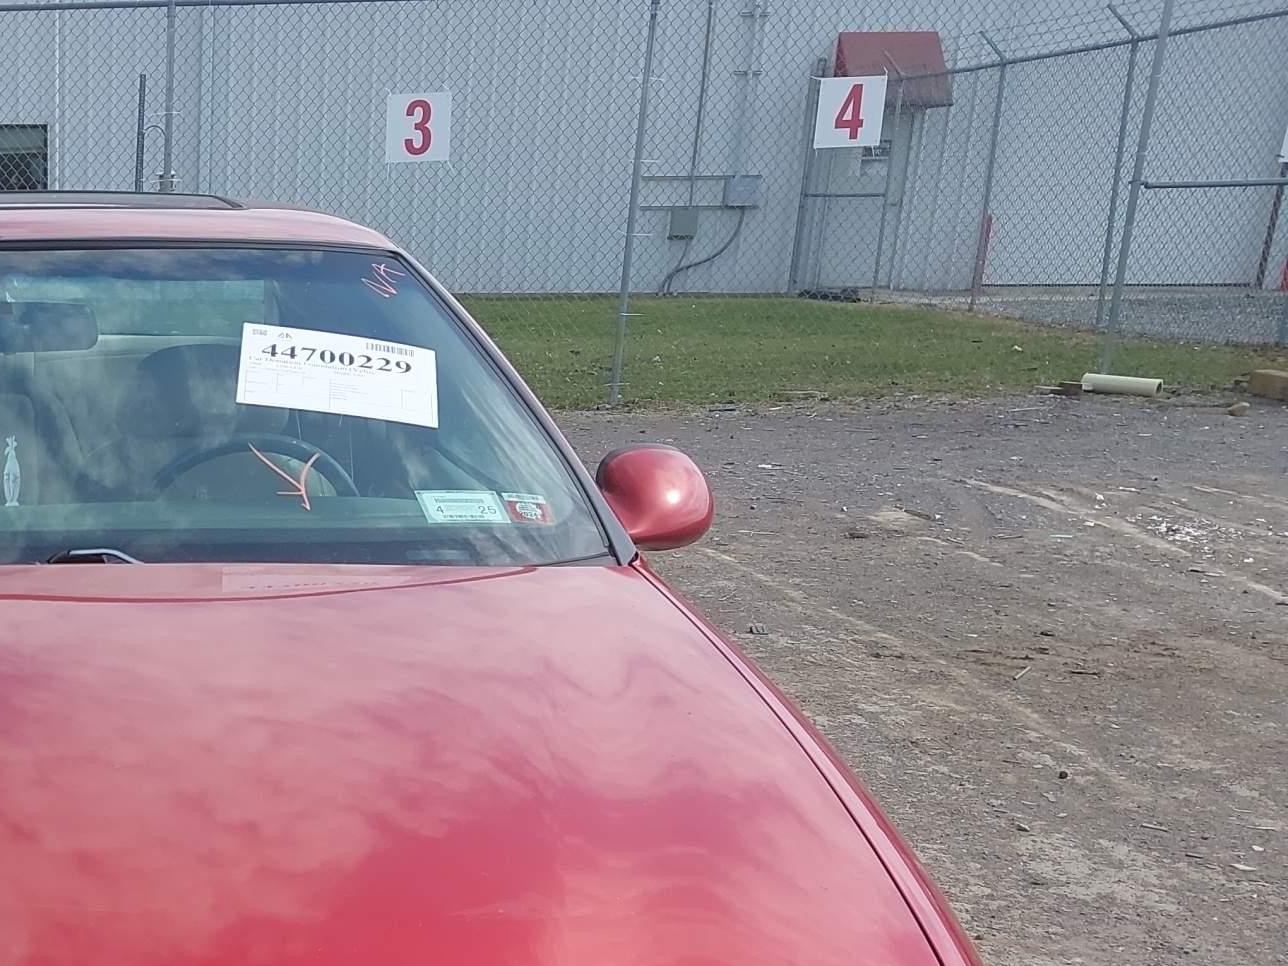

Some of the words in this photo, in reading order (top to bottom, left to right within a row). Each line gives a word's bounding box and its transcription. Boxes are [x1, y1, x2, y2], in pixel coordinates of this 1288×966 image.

[404, 99, 432, 156] 3
[834, 83, 864, 140] 4
[261, 343, 412, 374] 44700229
[478, 505, 497, 515] 25
